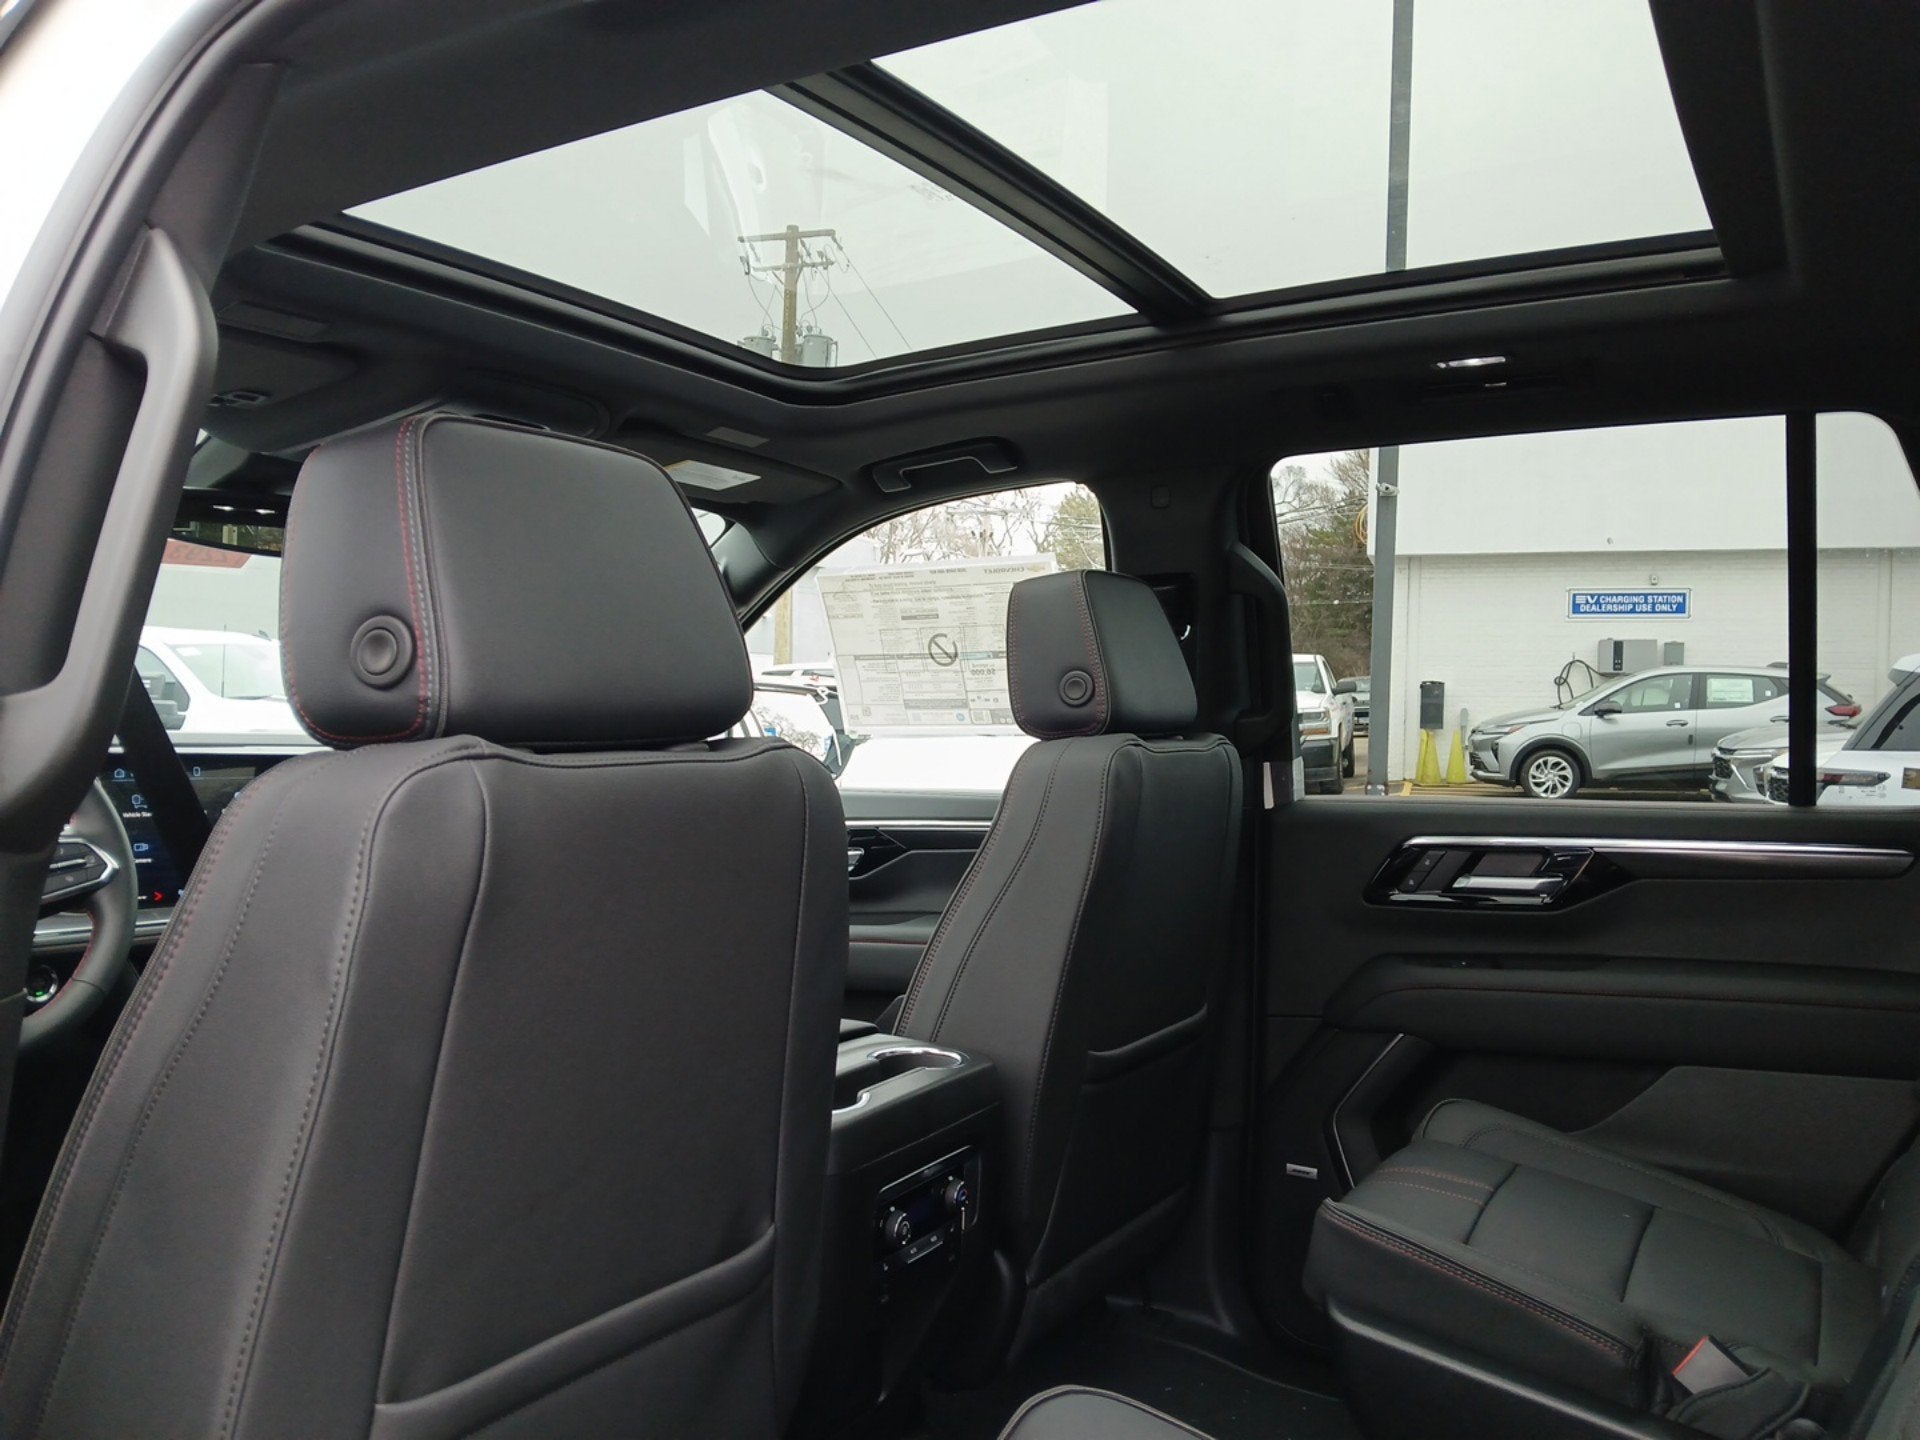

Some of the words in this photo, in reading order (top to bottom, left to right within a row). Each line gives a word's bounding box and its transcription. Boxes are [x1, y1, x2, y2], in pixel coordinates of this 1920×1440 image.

[1575, 595, 1598, 604] EV
[1600, 595, 1645, 604] CHARGING
[1647, 595, 1684, 604] STATION
[1580, 603, 1633, 612] DEALERSHIP
[1635, 603, 1653, 612] USE
[1655, 603, 1678, 612] ONLY
